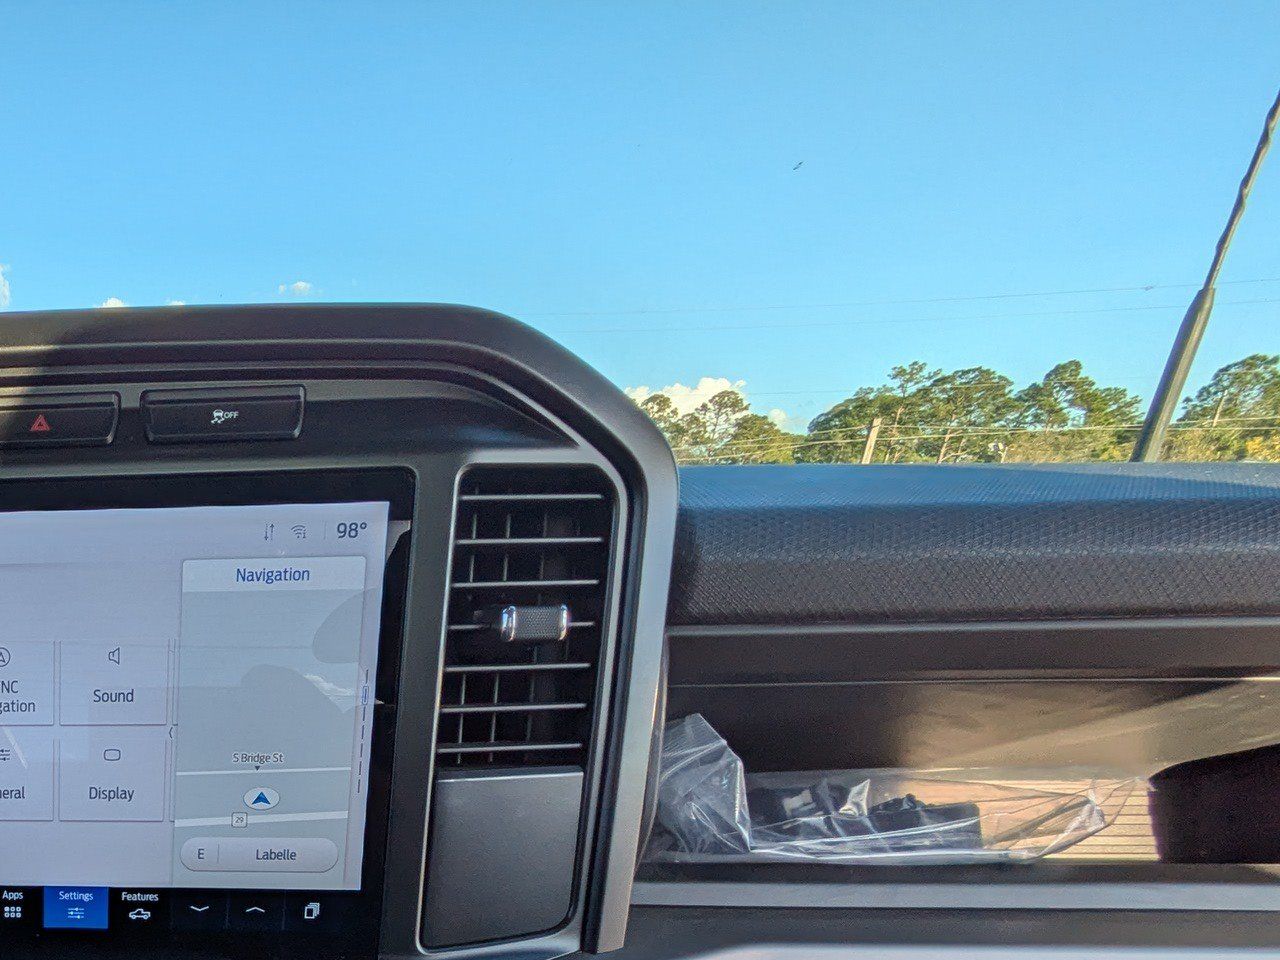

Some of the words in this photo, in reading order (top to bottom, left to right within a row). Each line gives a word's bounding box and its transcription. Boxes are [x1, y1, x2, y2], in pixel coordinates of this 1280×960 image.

[223, 411, 239, 419] OFF
[235, 567, 311, 585] Navigation
[93, 689, 134, 703] Sound
[232, 753, 239, 763] S
[241, 752, 271, 764] Bridge
[272, 752, 284, 762] St
[88, 786, 135, 801] Display
[234, 815, 244, 824] 29
[197, 848, 205, 860] E
[256, 848, 297, 861] Labelle
[2, 890, 24, 901] Apps
[59, 891, 94, 902] Settings
[121, 892, 159, 902] Features
